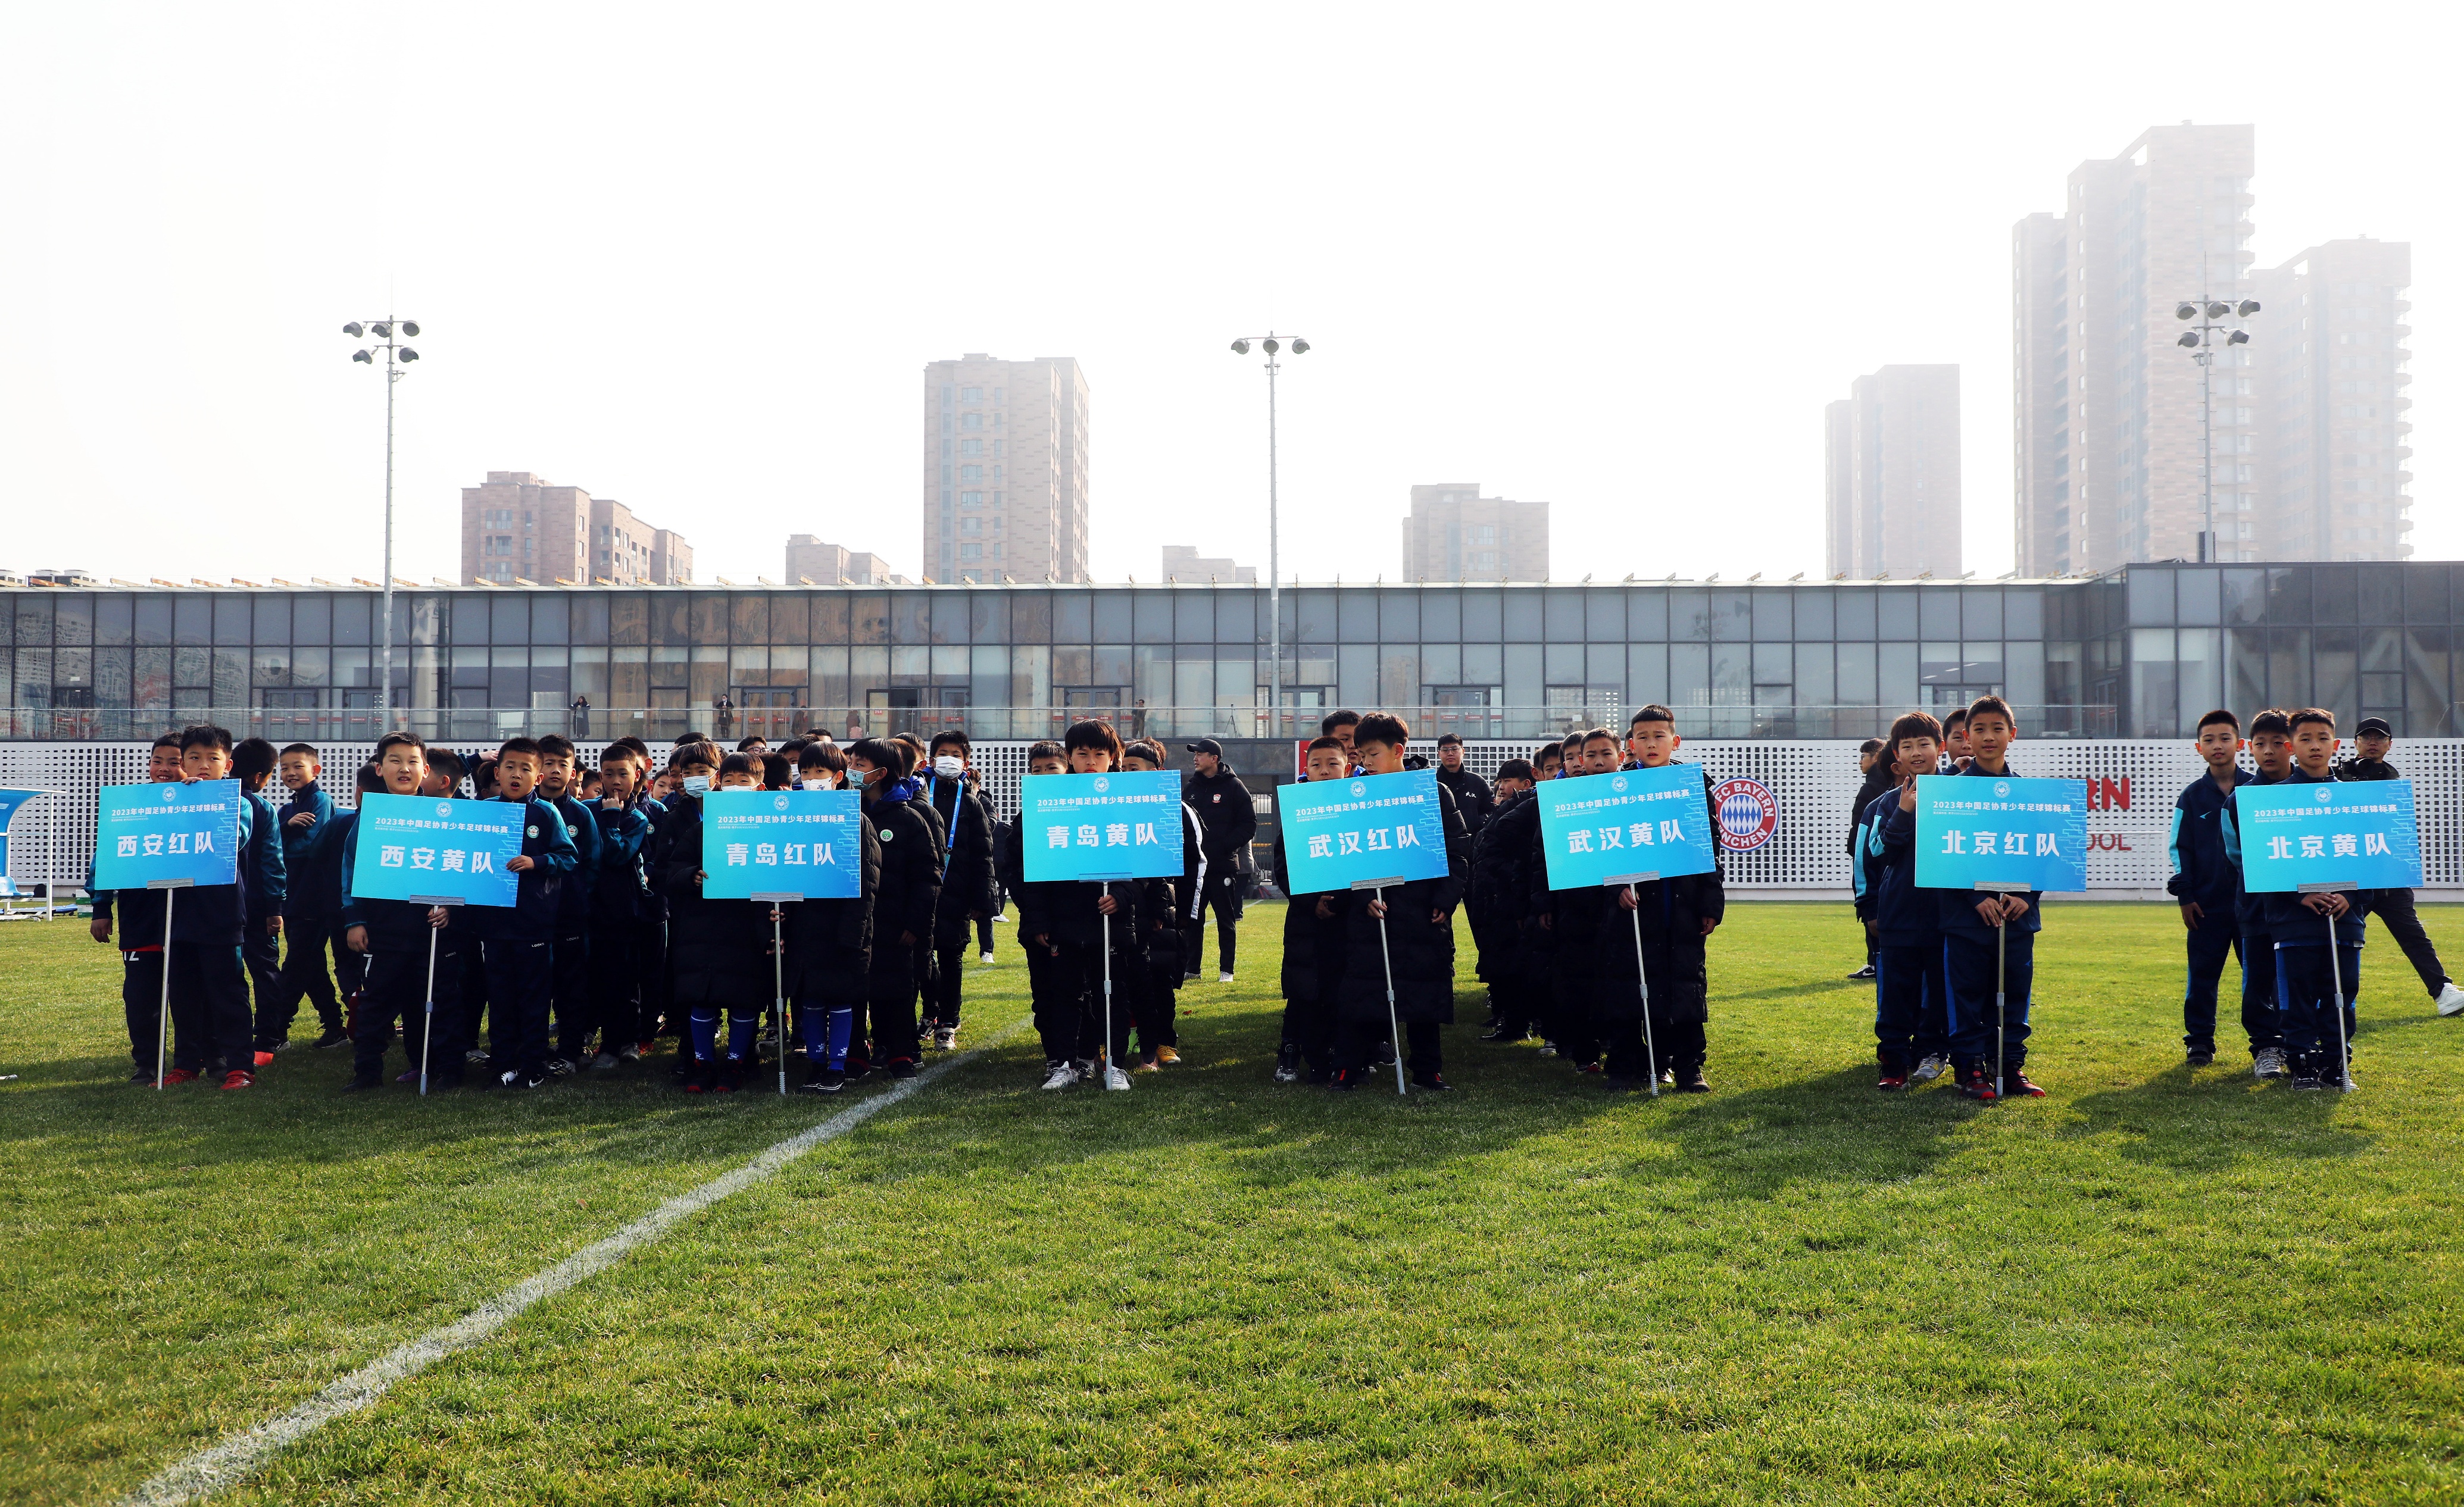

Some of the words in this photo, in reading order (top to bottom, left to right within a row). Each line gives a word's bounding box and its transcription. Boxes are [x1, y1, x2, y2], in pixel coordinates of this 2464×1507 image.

[111, 803, 226, 816] 2023年中国足协青少年足球锦标赛
[1037, 795, 1167, 806] 2023年中国足协青少年足球锦标赛
[1295, 795, 1425, 816] 2023年中国足协青少年足球锦标赛
[1554, 789, 1690, 812] 2023年中国足协青少年足球锦标赛
[1715, 786, 1731, 803] FC
[1734, 782, 1775, 817] BAYERN
[1933, 801, 2071, 812] 2023年中国足协青少年足球锦标赛
[2254, 804, 2397, 817] 2023年中国足协青少年足球锦标赛
[375, 817, 508, 834] 2023年中国足协青少年足球锦标赛
[718, 815, 845, 823] 2023年中国足协青少年足球锦标赛
[117, 831, 214, 857] 西安红队
[1047, 823, 1158, 849] 青岛黄队
[1308, 824, 1420, 858] 武汉红队
[1567, 819, 1685, 853] 武汉黄队
[1716, 823, 1768, 847] NCHEN
[1941, 830, 2060, 857] 北京红队
[2266, 833, 2391, 859] 北京黄队
[380, 845, 494, 874] 西安黄队
[726, 842, 835, 866] 青岛红队
